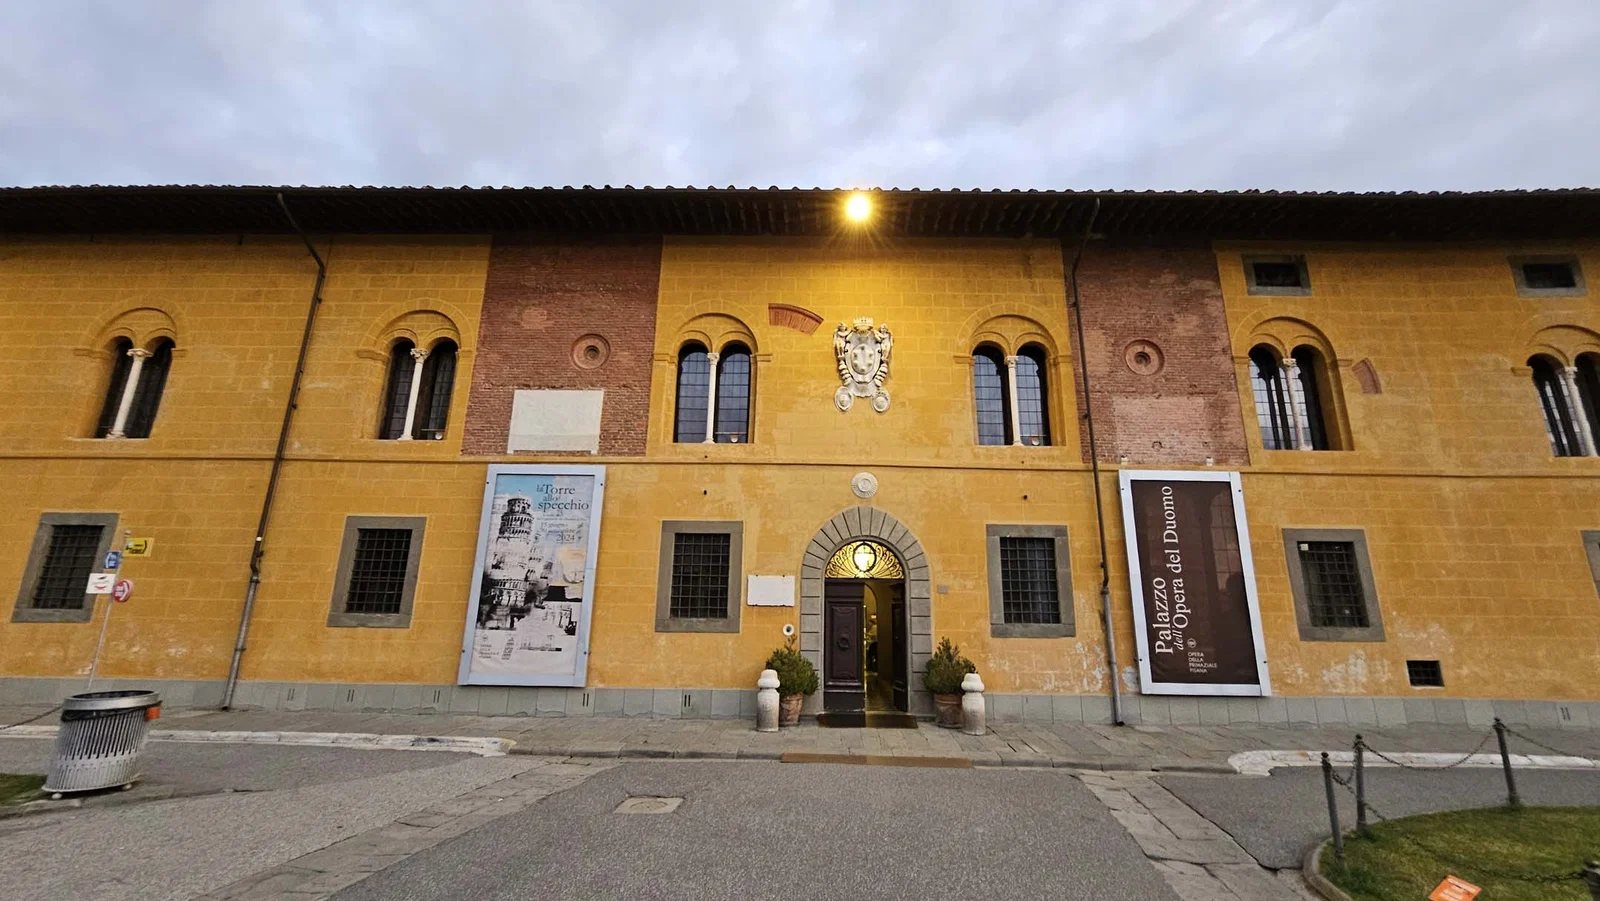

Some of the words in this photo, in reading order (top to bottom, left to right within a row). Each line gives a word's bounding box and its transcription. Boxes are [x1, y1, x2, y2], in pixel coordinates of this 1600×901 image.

[543, 484, 576, 495] Torre
[537, 499, 590, 512] specchio
[1161, 486, 1179, 543] Duomo
[1164, 549, 1182, 574] del
[1152, 577, 1174, 655] Palazzo
